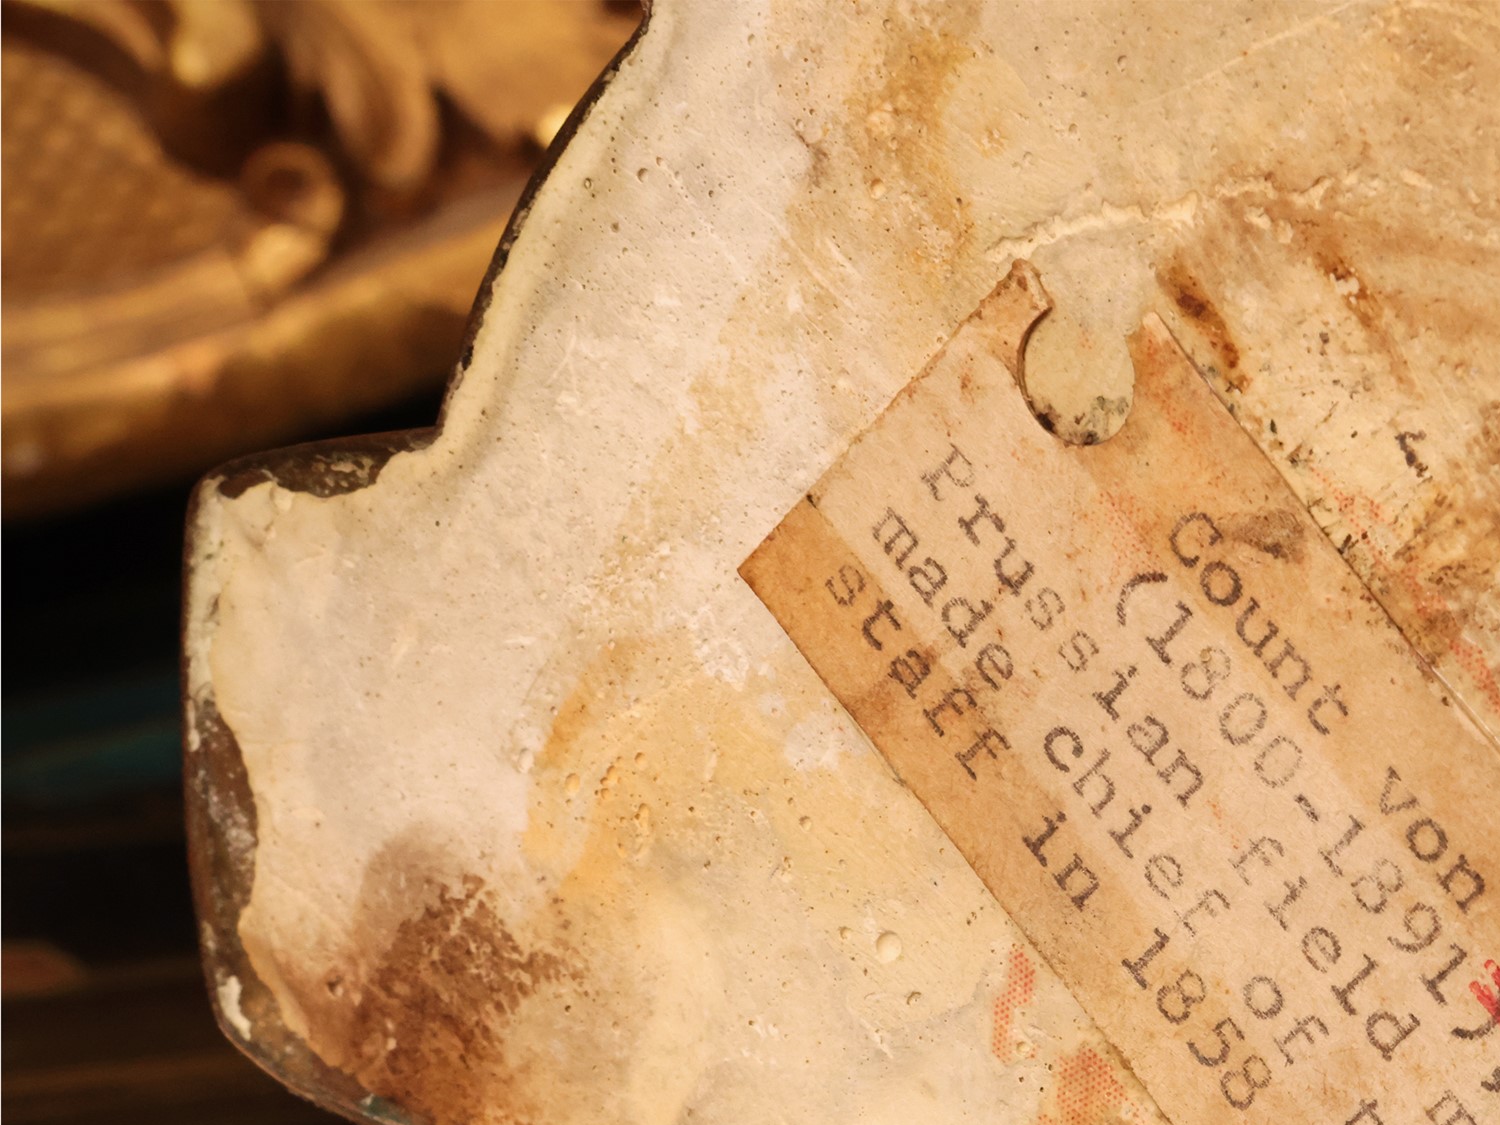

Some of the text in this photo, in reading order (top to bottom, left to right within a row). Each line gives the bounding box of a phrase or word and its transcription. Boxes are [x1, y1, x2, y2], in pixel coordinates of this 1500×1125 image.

[824, 564, 1012, 781] staff
[1022, 811, 1099, 912] in
[872, 507, 1014, 691] made
[1044, 726, 1231, 937] chief
[1242, 976, 1329, 1067] of
[920, 443, 1204, 808] Prussian
[1229, 836, 1421, 1062] field
[1168, 511, 1349, 735] Count
[1379, 766, 1486, 913] von
